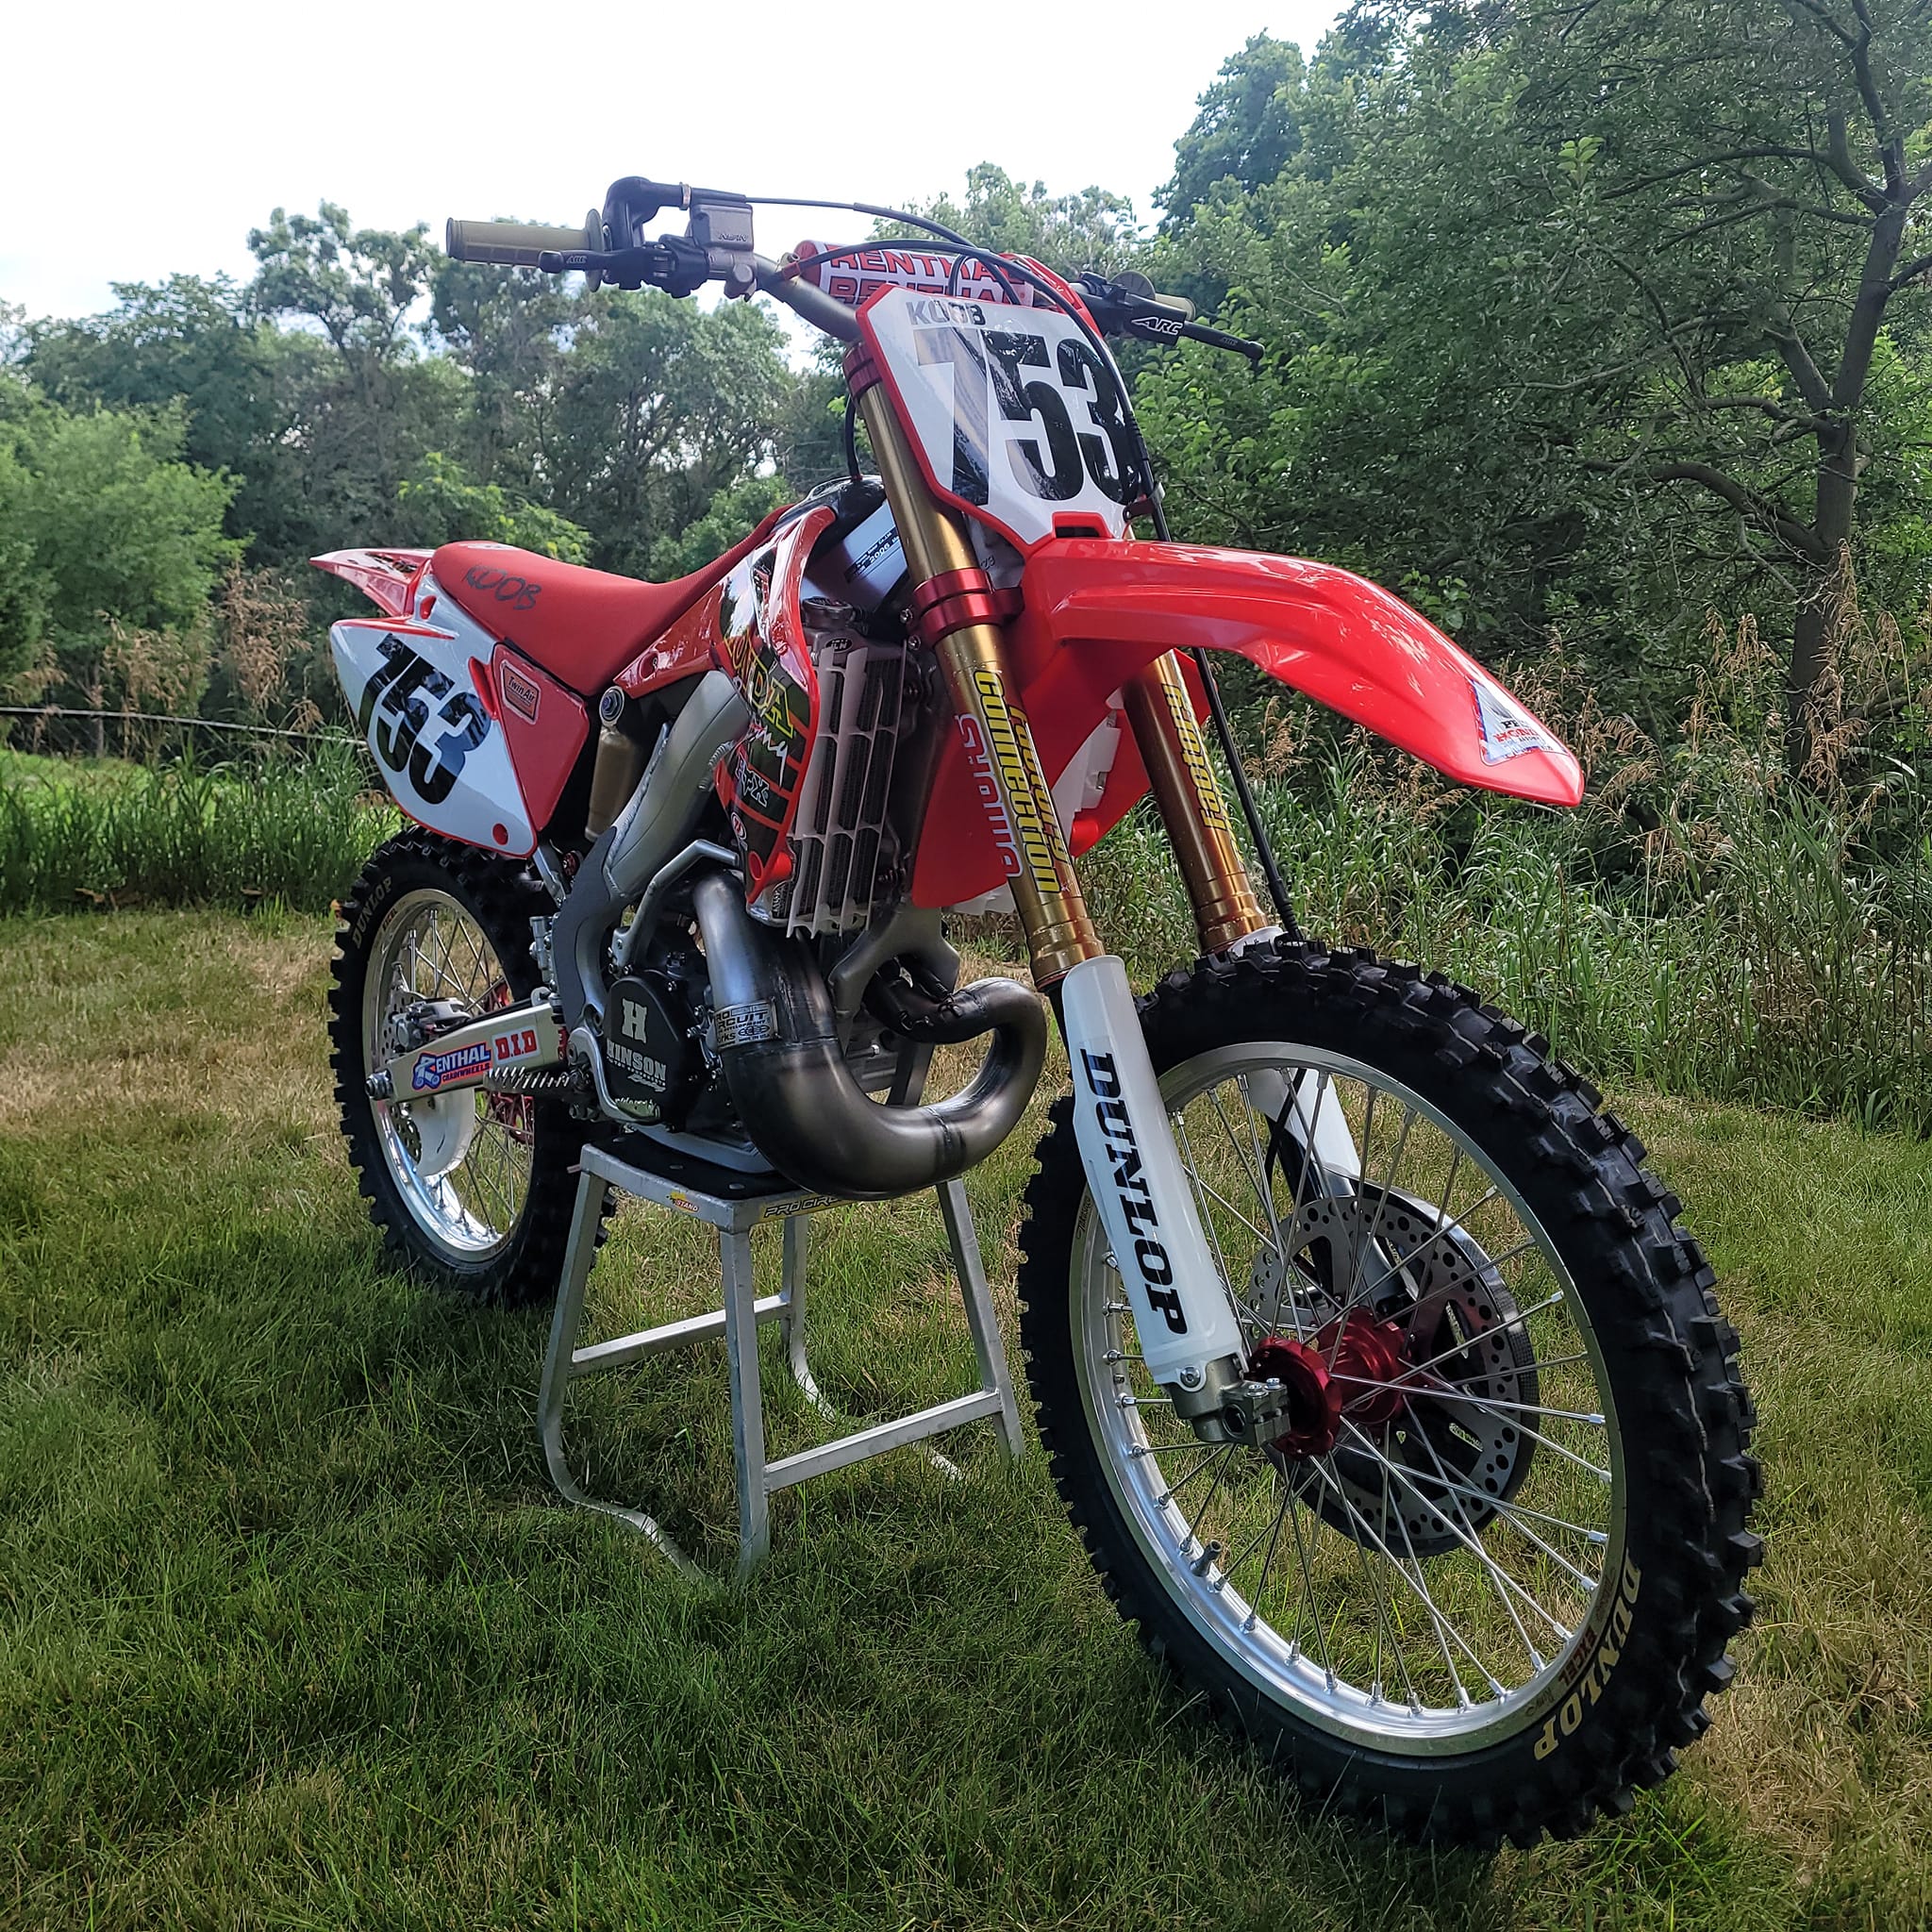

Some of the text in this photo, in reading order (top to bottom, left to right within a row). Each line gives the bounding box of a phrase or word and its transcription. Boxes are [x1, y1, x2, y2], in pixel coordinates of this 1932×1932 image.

[1131, 316, 1184, 336] ARC
[508, 675, 525, 695] Twin
[524, 689, 536, 702] Air
[1160, 682, 1228, 832] Factory
[973, 669, 1063, 895] Connection
[352, 875, 391, 950] DUNLOP
[621, 997, 648, 1044] H
[494, 1029, 538, 1060] D.I.D
[606, 1037, 667, 1081] HINSON
[675, 1199, 699, 1212] STAND
[764, 1201, 802, 1219] PRO
[1079, 1048, 1189, 1336] DUNLOP
[1533, 1547, 1642, 1761] DUNLOP
[1558, 1624, 1599, 1688] EXCEL
